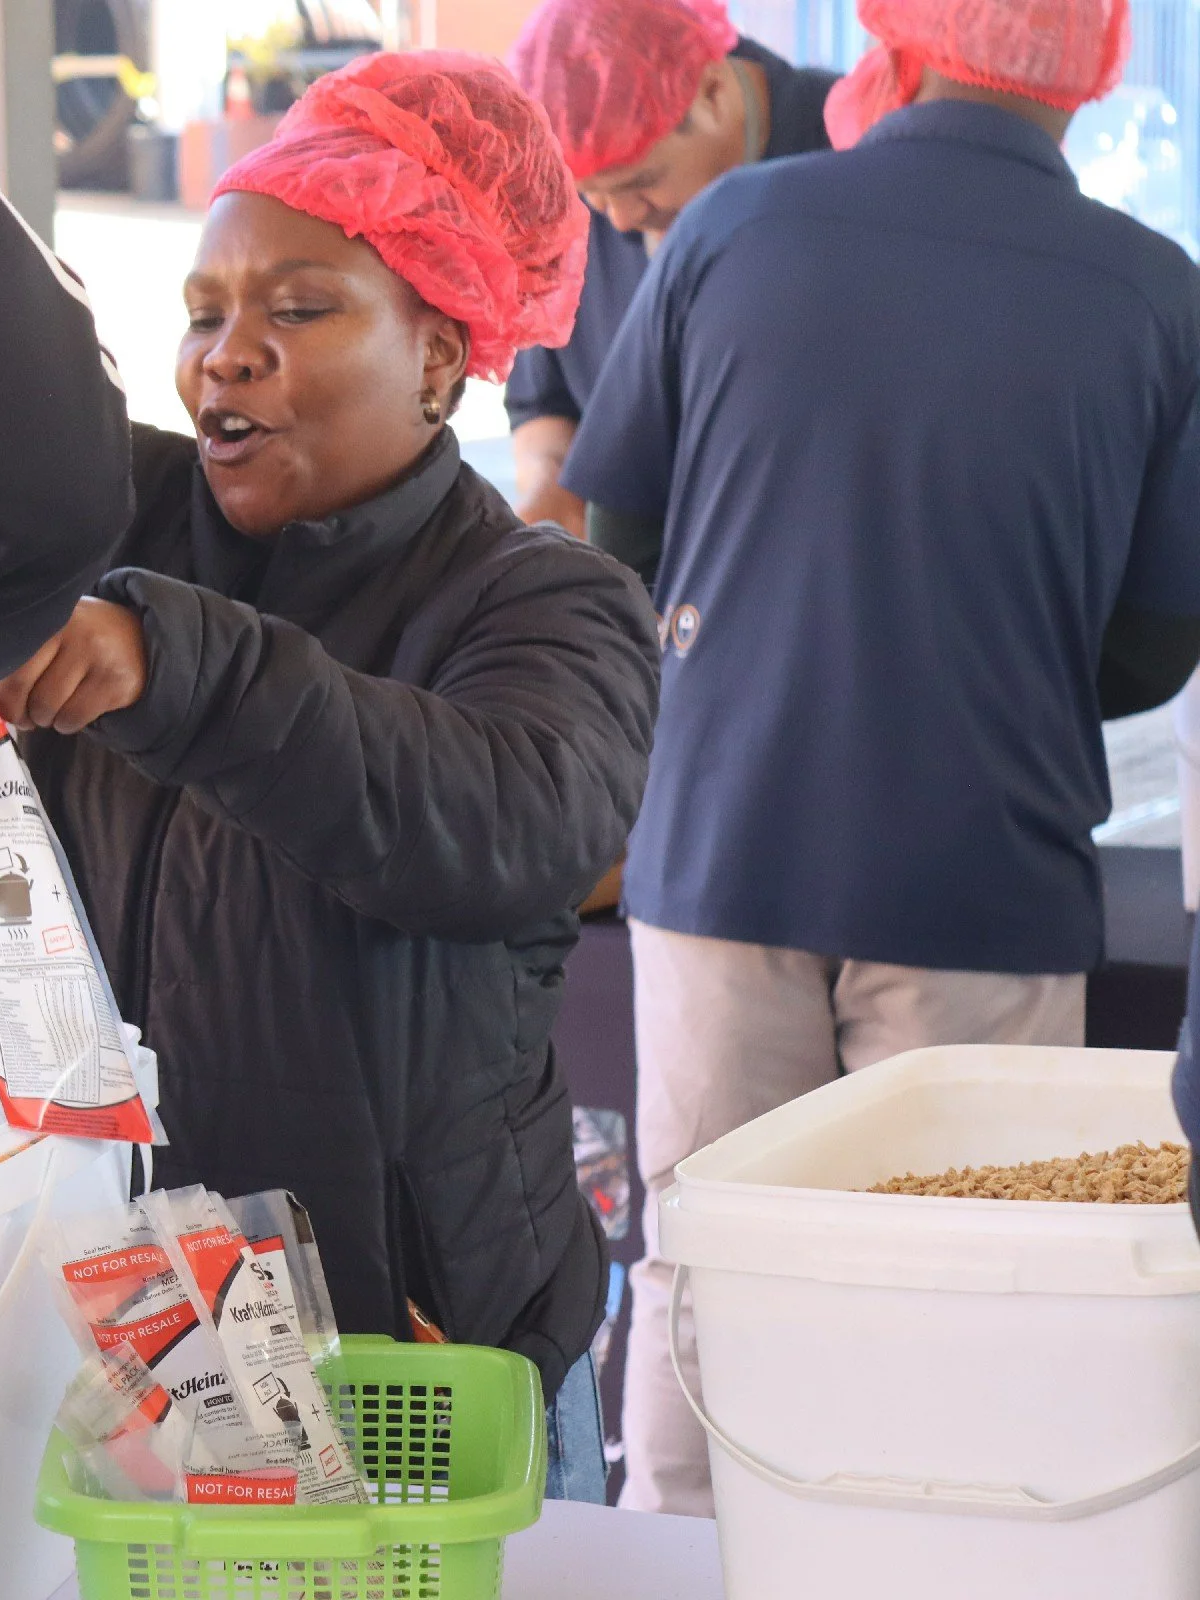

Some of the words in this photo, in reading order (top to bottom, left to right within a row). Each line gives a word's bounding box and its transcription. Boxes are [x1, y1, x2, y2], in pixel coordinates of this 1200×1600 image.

[186, 1240, 203, 1252] NOT
[202, 1236, 217, 1249] FOR
[73, 1264, 99, 1279] NOT
[102, 1257, 128, 1273] FOR
[114, 1330, 137, 1343] FOR
[138, 1312, 181, 1338] RESALE
[121, 1365, 140, 1385] PACK
[210, 1460, 224, 1468] Seal
[195, 1483, 223, 1495] NOT
[227, 1485, 252, 1498] FOR
